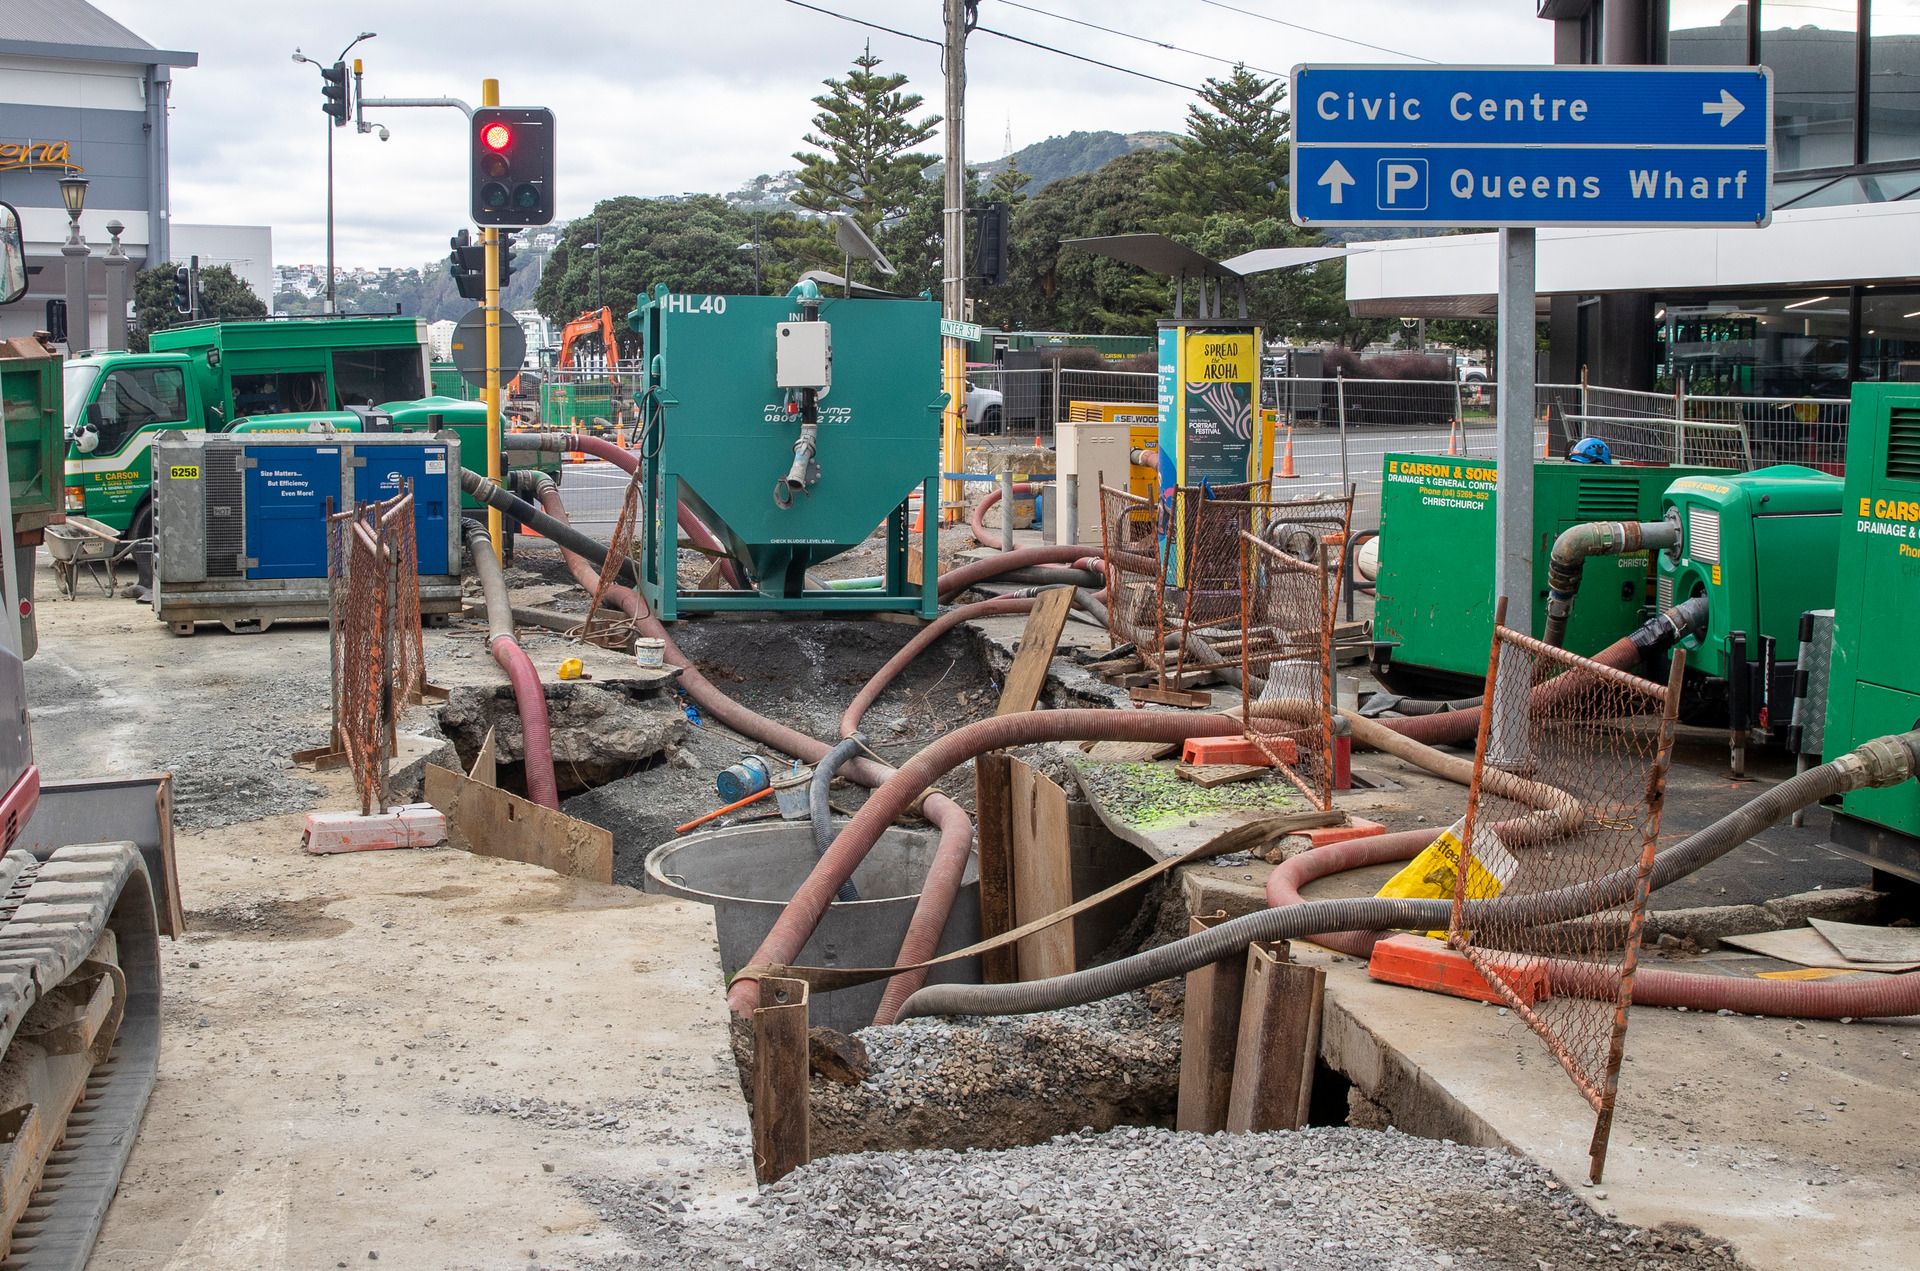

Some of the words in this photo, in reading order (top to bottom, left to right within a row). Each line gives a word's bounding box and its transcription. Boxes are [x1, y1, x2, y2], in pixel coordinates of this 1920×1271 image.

[1317, 91, 1421, 120] Civic
[1450, 92, 1588, 121] Centre
[0, 141, 71, 164] ena
[1387, 164, 1419, 204] P
[1450, 168, 1600, 200] Queens
[1629, 170, 1747, 199] Wharf
[669, 294, 727, 315] HL40
[941, 322, 963, 335] UNTER
[967, 326, 976, 337] ST
[1204, 343, 1238, 360] SPREAD
[1203, 363, 1238, 379] AROHA
[828, 415, 851, 424] 747
[1121, 415, 1159, 423] SELWOOD
[94, 473, 103, 481] E.
[105, 472, 139, 480] CARSON
[172, 468, 197, 477] 6258
[1389, 461, 1398, 473] E
[1400, 462, 1450, 477] CARSON
[1453, 466, 1462, 479] &
[1465, 467, 1498, 482] SONS
[1388, 474, 1424, 485] DRAINAGE
[1432, 478, 1467, 488] GENERAL
[1419, 486, 1441, 496] Phone
[1442, 488, 1455, 498] (04)
[1422, 497, 1484, 510] CHRISTCHURCH
[1859, 497, 1871, 517] E
[1874, 499, 1920, 522] CARS
[1857, 520, 1907, 537] DRAINAGE
[1908, 526, 1916, 538] &
[1618, 558, 1649, 568] CHRISTC
[1433, 839, 1461, 867] etfee
